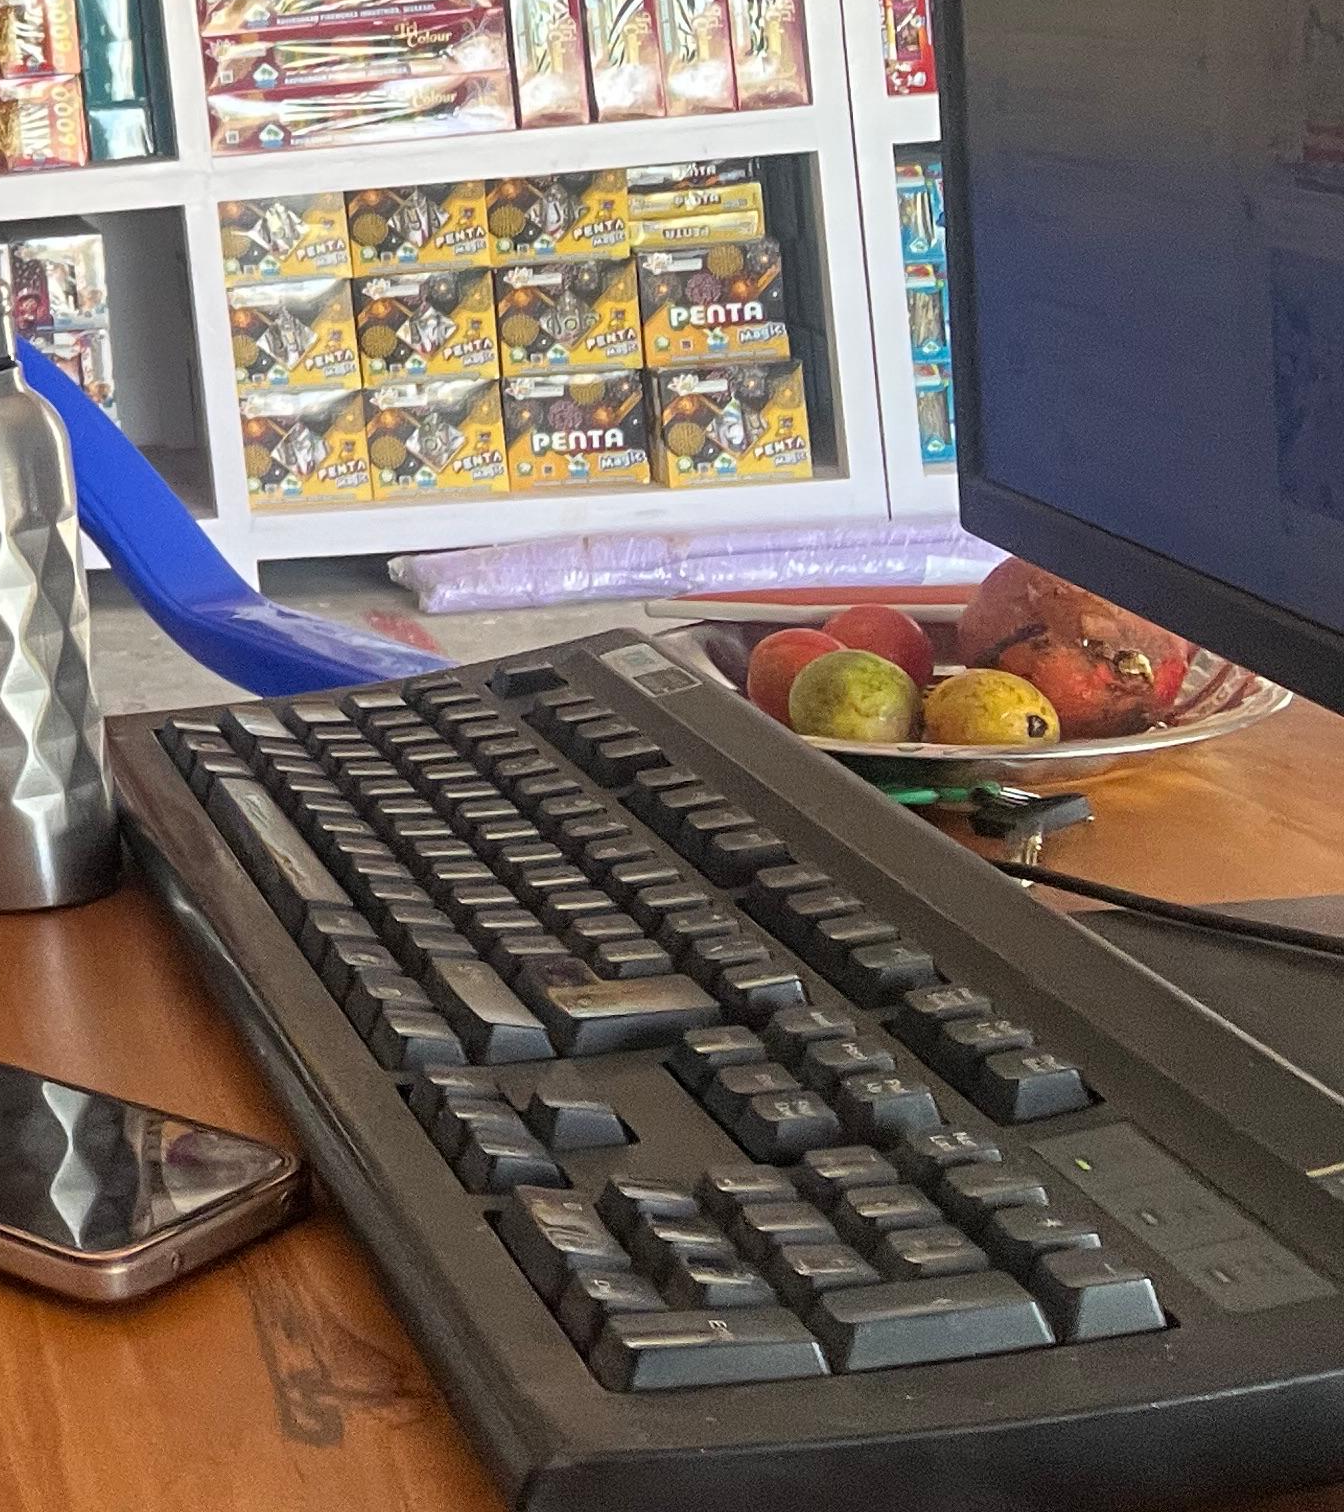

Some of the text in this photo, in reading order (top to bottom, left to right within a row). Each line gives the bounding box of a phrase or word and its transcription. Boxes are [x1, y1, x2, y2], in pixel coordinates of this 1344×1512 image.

[407, 30, 453, 48] Colour
[412, 92, 458, 109] Colour
[435, 226, 486, 248] PENTA
[573, 219, 625, 240] PENTA
[296, 239, 346, 261] PENTA
[669, 300, 764, 329] PENTA
[585, 328, 637, 351] PENTA
[737, 323, 786, 344] Magic
[443, 337, 494, 360] PENTA
[304, 350, 355, 371] PENTA
[531, 428, 625, 454] PENTA
[754, 437, 806, 459] PENTA
[317, 459, 367, 482] PENTA
[452, 451, 503, 472] PENTA
[598, 449, 647, 470] Magic
